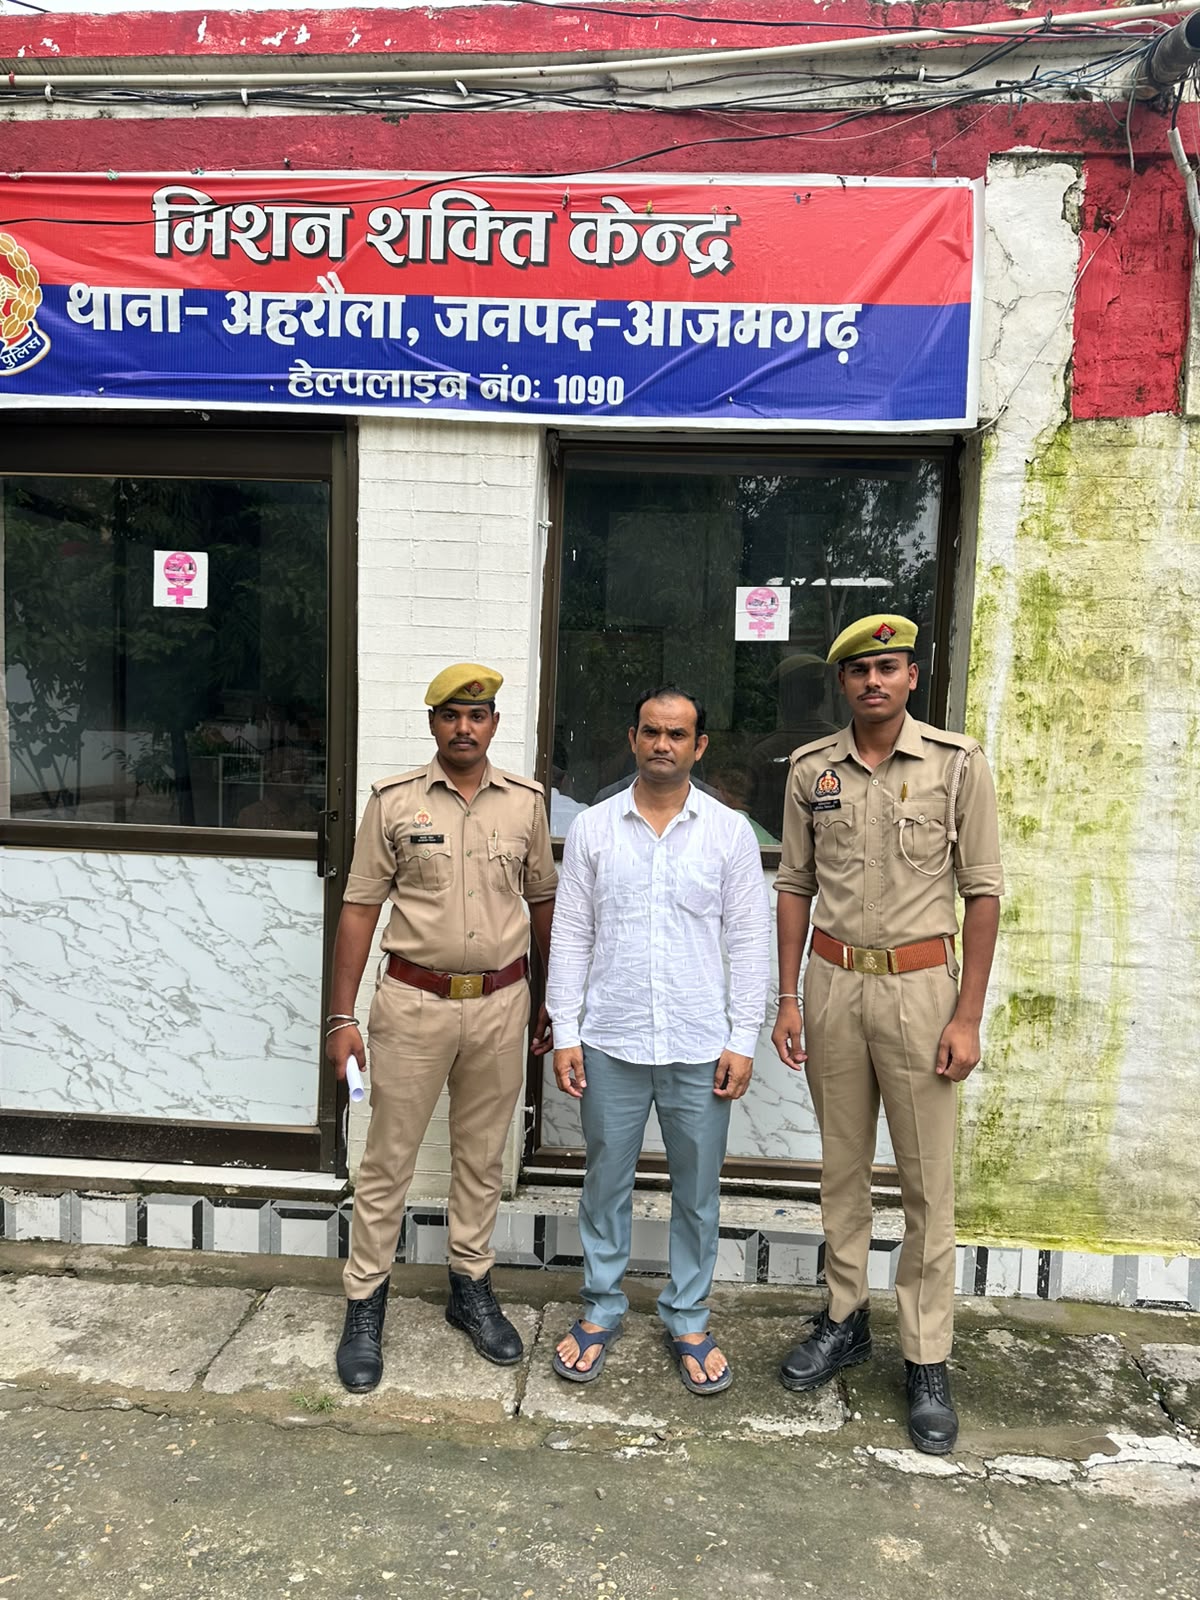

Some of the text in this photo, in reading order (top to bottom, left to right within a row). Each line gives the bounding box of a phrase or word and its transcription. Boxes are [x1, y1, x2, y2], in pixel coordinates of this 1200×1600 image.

[152, 185, 740, 274] मिशन शक्ति केन्द्र
[66, 283, 208, 333] थाना-
[222, 272, 418, 346] अहरौला,
[1, 336, 41, 369] पुलिस
[288, 359, 470, 404] हेल्पलाइन
[554, 375, 624, 405] 1090
